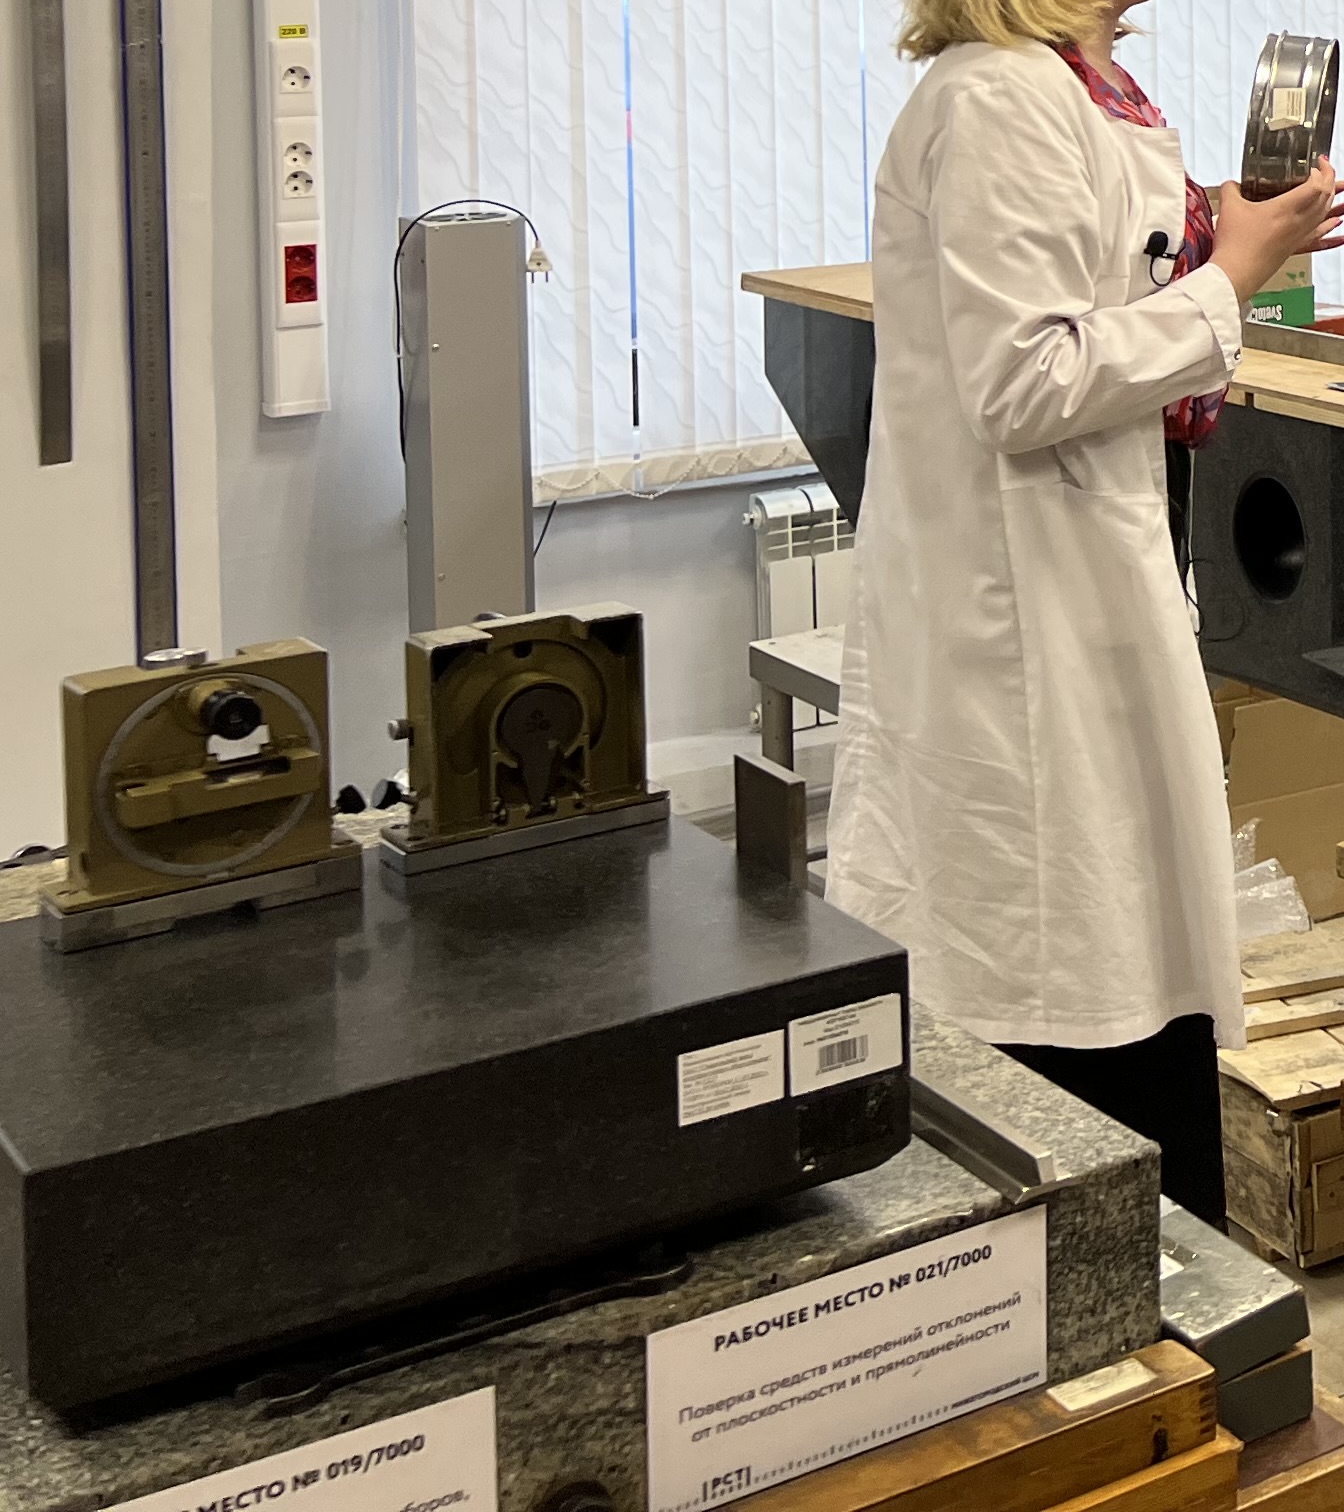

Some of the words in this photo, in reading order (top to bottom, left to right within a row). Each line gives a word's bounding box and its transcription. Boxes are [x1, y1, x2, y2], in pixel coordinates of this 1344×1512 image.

[714, 1306, 810, 1351] РАБОЧЕЕ
[813, 1282, 885, 1319] МЕСТО
[888, 1274, 911, 1294] №
[915, 1244, 992, 1282] 021/7000
[678, 1389, 756, 1425] Поверка
[760, 1363, 828, 1397] средств
[832, 1326, 923, 1371] измерений
[927, 1292, 1022, 1336] отклонений
[691, 1426, 712, 1443] от
[715, 1379, 847, 1437] плоскостности
[850, 1373, 862, 1386] и
[865, 1320, 1012, 1382] прямолинейности
[291, 1469, 321, 1492] №
[326, 1434, 425, 1480] 019/7000
